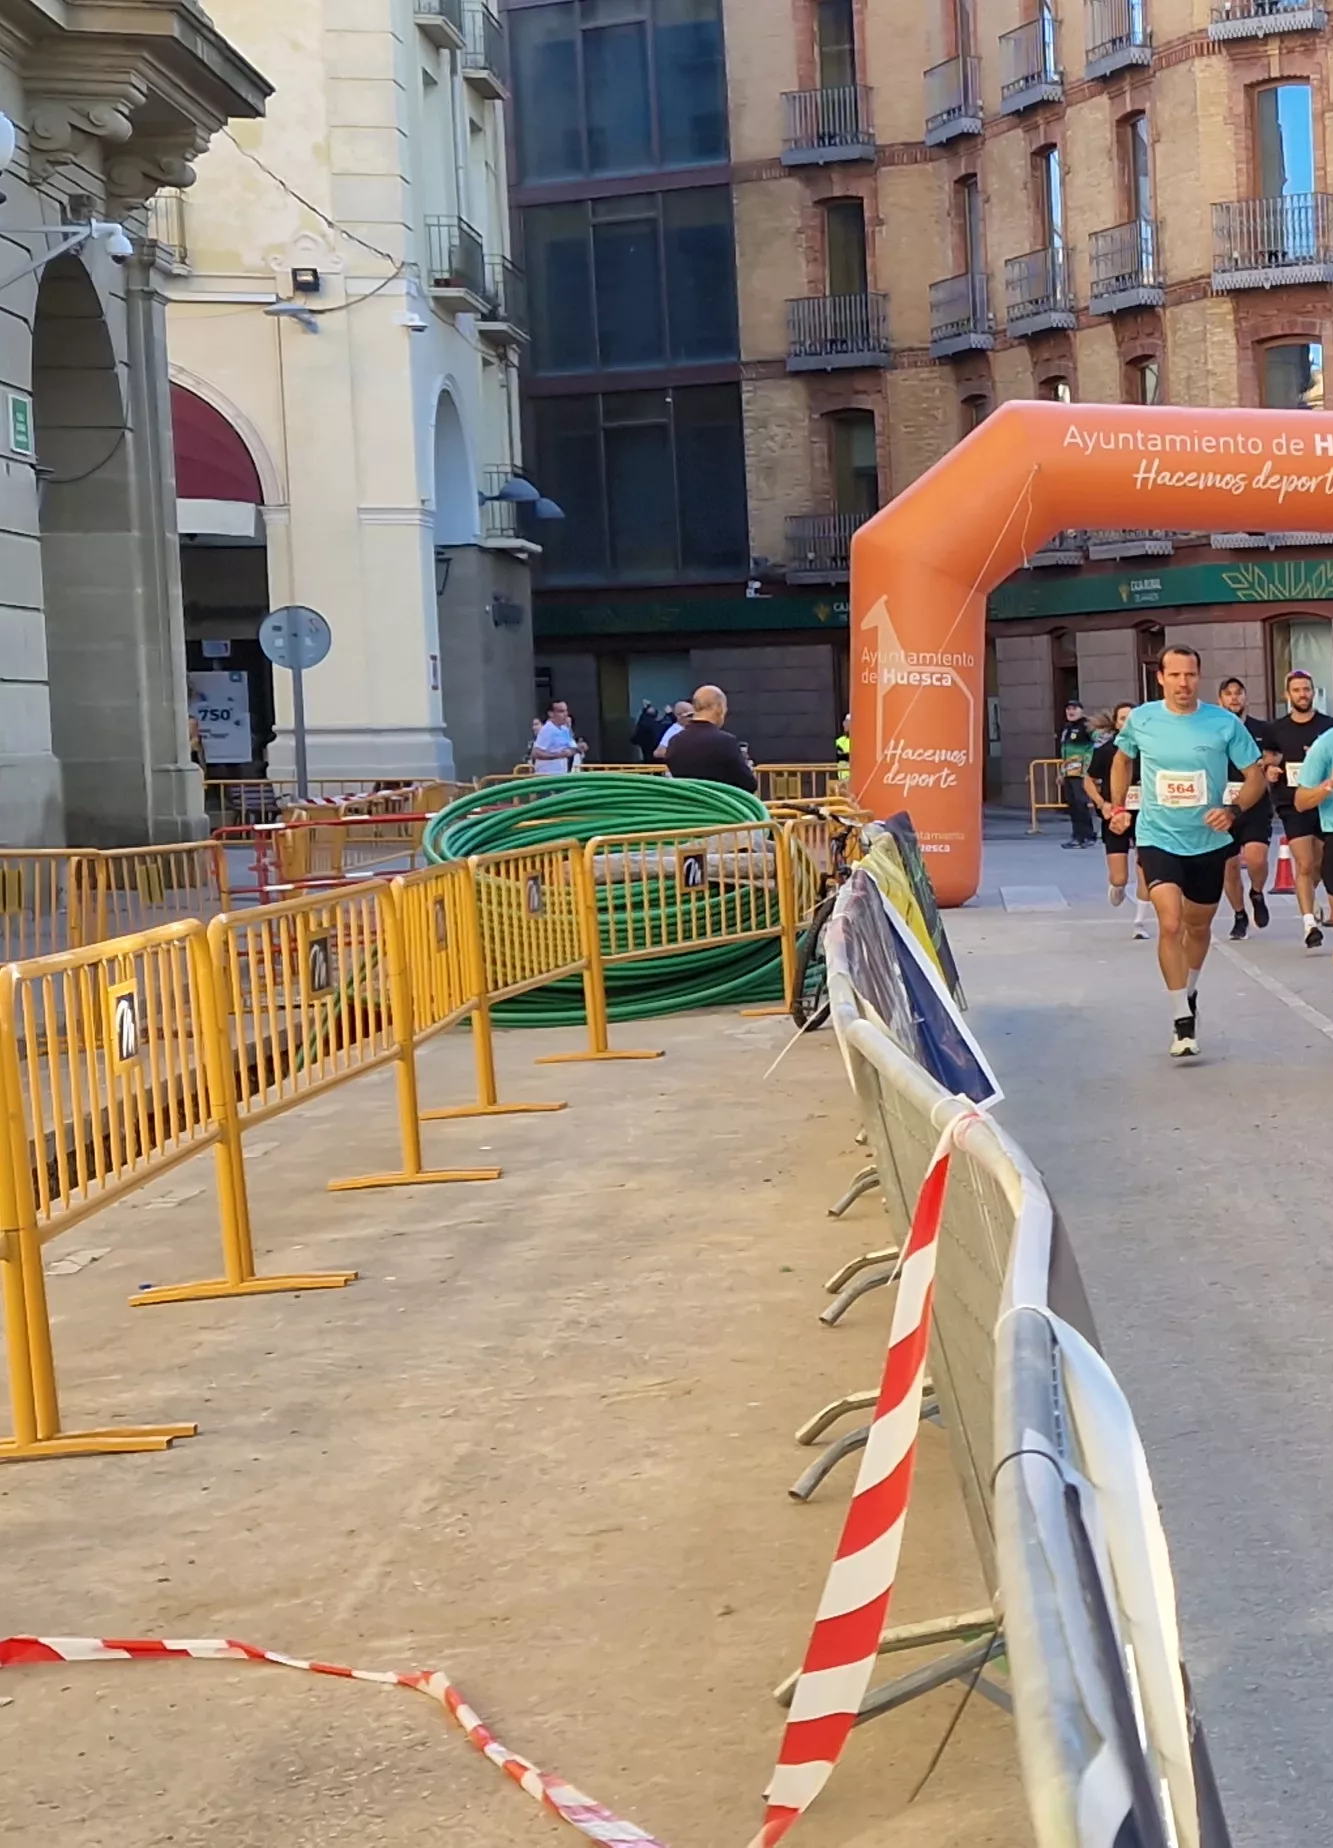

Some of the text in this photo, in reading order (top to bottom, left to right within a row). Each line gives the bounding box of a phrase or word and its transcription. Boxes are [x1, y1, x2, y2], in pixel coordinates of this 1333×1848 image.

[1063, 425, 1263, 456] Ayuntamiento
[1272, 433, 1304, 455] de
[1133, 458, 1248, 495] Hacemos
[861, 646, 974, 669] Ayuntamiento
[861, 668, 952, 688] de Huesca
[883, 739, 967, 765] Hacemos
[883, 766, 958, 797] deporte
[1167, 783, 1195, 794] 564
